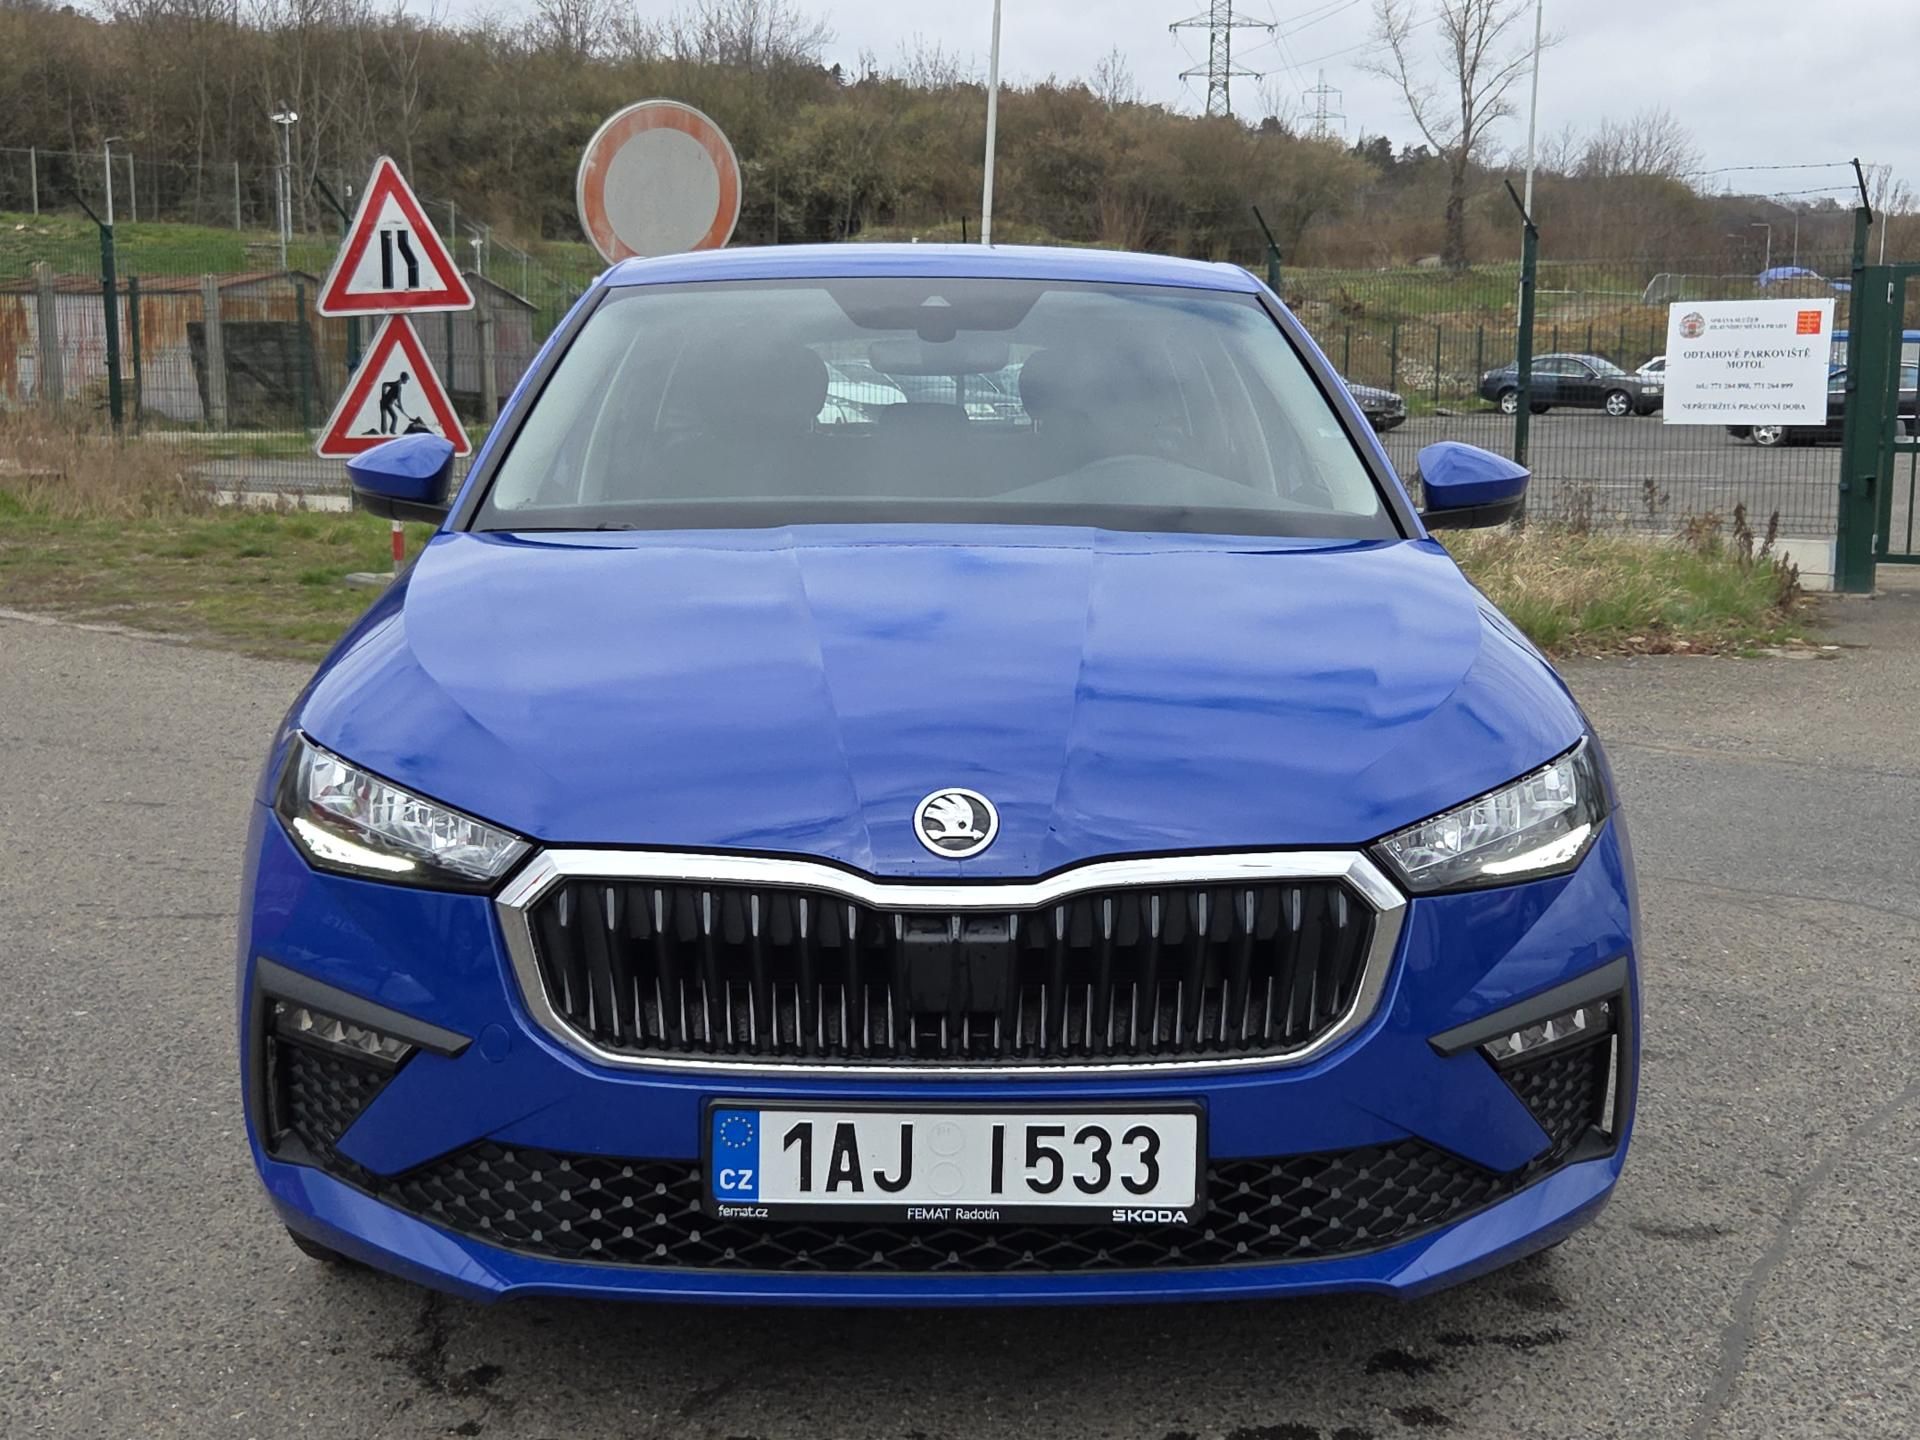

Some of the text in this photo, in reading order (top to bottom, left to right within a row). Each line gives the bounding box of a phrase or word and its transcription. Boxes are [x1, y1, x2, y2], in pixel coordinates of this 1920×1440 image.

[1683, 347, 1811, 359] ODTAHOVÉ PARKOVIŠTĚ
[1726, 360, 1765, 369] MOTOL
[1739, 402, 1781, 410] PRACOVNÍ
[782, 1121, 914, 1192] 1AJ
[718, 1168, 753, 1190] CZ
[718, 1204, 768, 1218] femat.cz
[906, 1207, 1000, 1220] FEMAT Radotín
